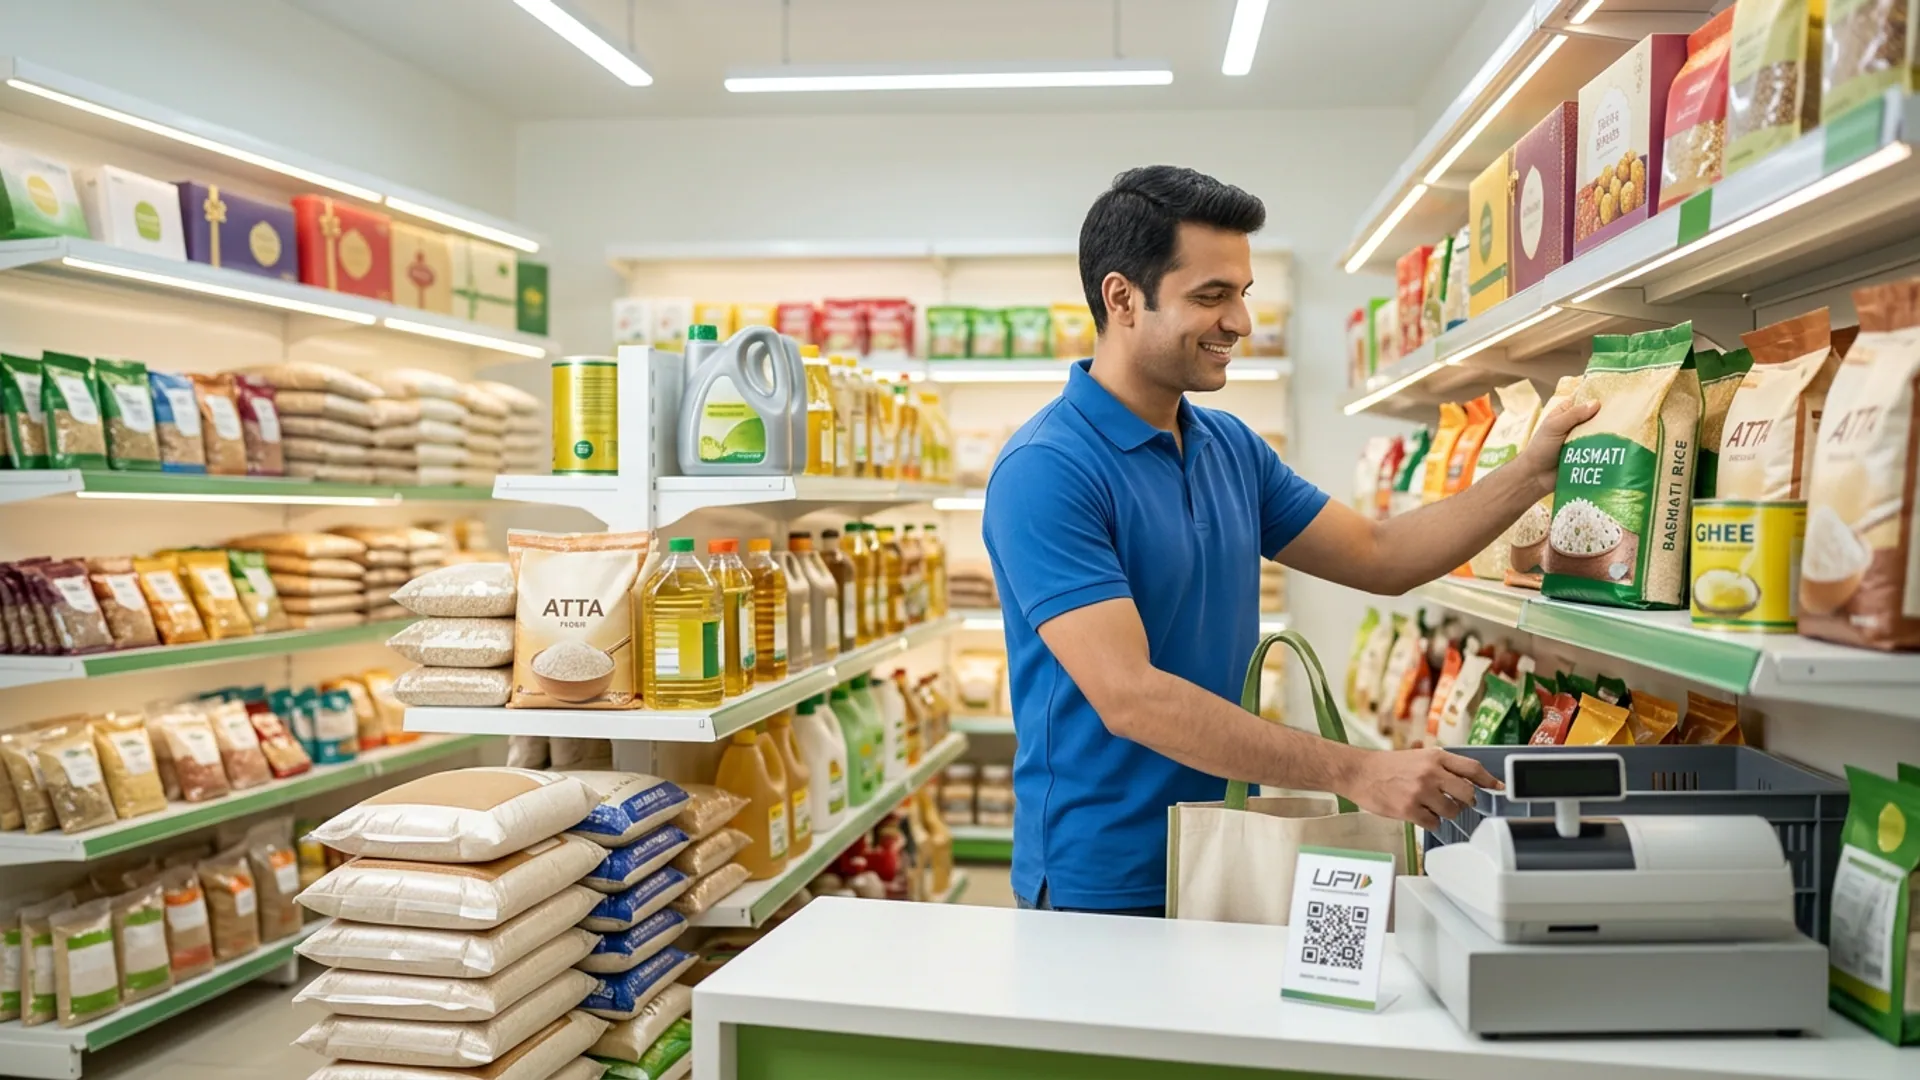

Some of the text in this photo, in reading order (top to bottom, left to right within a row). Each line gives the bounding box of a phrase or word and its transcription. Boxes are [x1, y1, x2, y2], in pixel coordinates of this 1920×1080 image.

[1726, 419, 1774, 448] ATTA
[1564, 447, 1626, 465] BASMATI
[1569, 467, 1604, 485] RICE
[1662, 439, 1687, 551] BASMATI RICE
[1695, 523, 1755, 543] GHEE
[542, 598, 604, 617] ATTA
[1312, 867, 1362, 889] UPI
